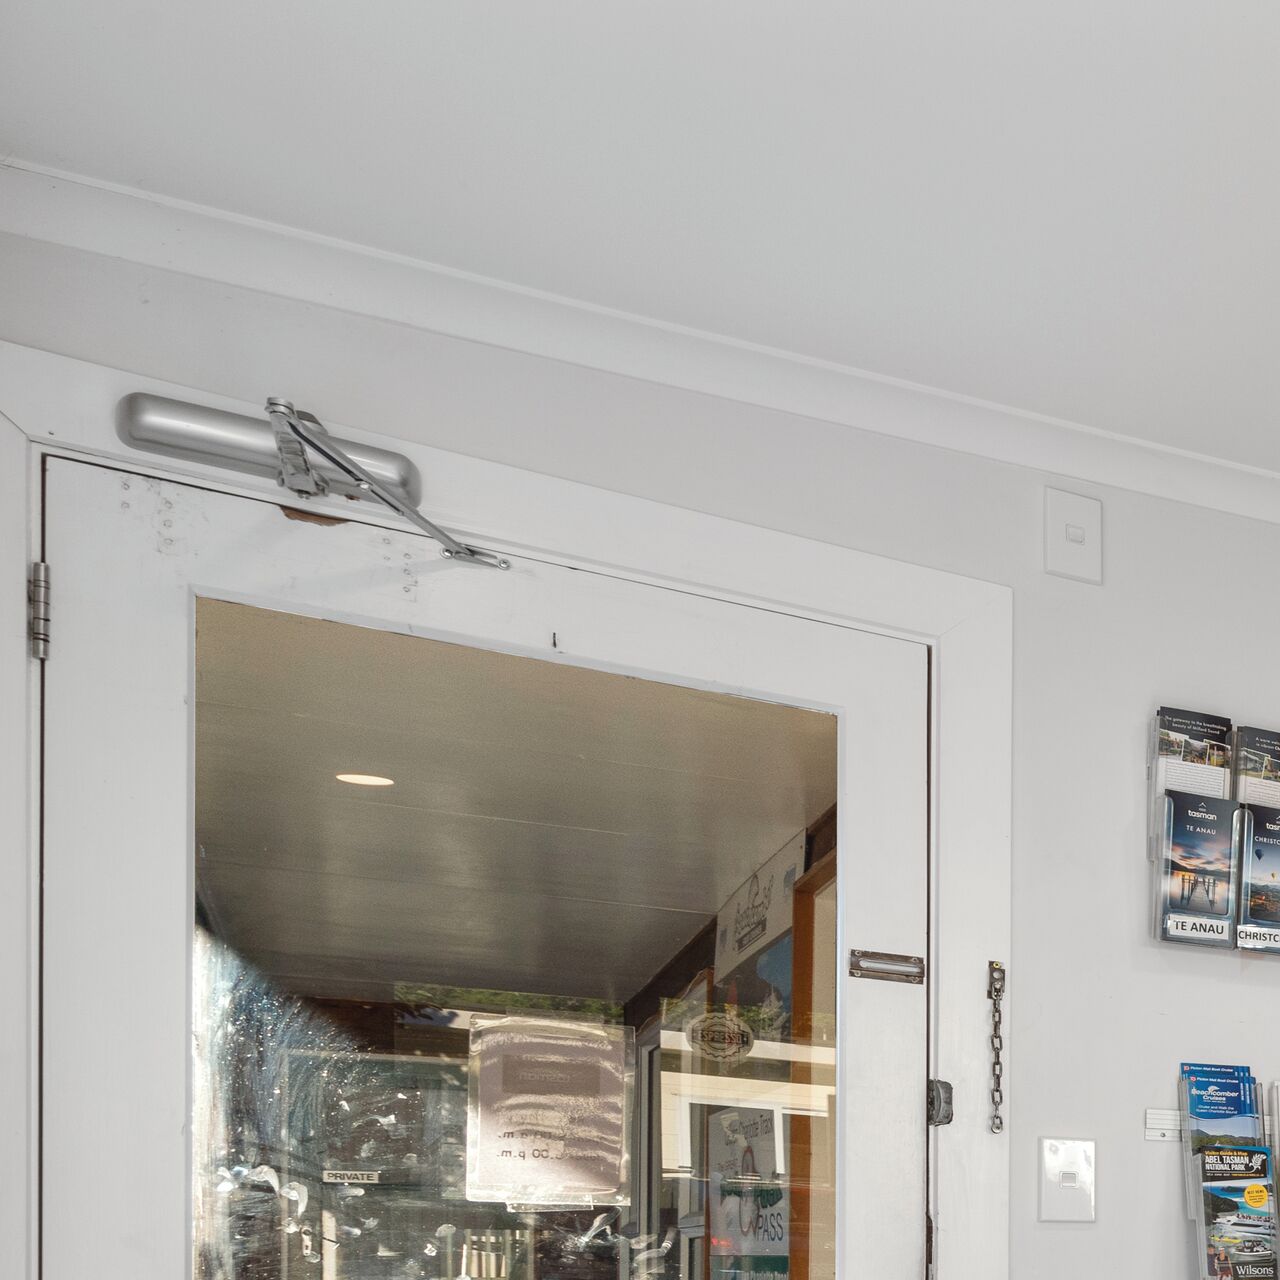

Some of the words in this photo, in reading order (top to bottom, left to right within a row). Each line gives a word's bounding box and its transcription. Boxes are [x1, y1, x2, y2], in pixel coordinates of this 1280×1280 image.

[1188, 808, 1217, 821] tasman
[1186, 825, 1195, 833] TE
[1197, 826, 1216, 835] ANAU
[1174, 920, 1188, 932] TE
[1190, 922, 1224, 936] ANAU
[1191, 1087, 1239, 1096] Beachcomber
[1222, 1156, 1249, 1164] TASMAN
[757, 1212, 783, 1241] PASS
[1236, 1265, 1274, 1275] Wilsons
